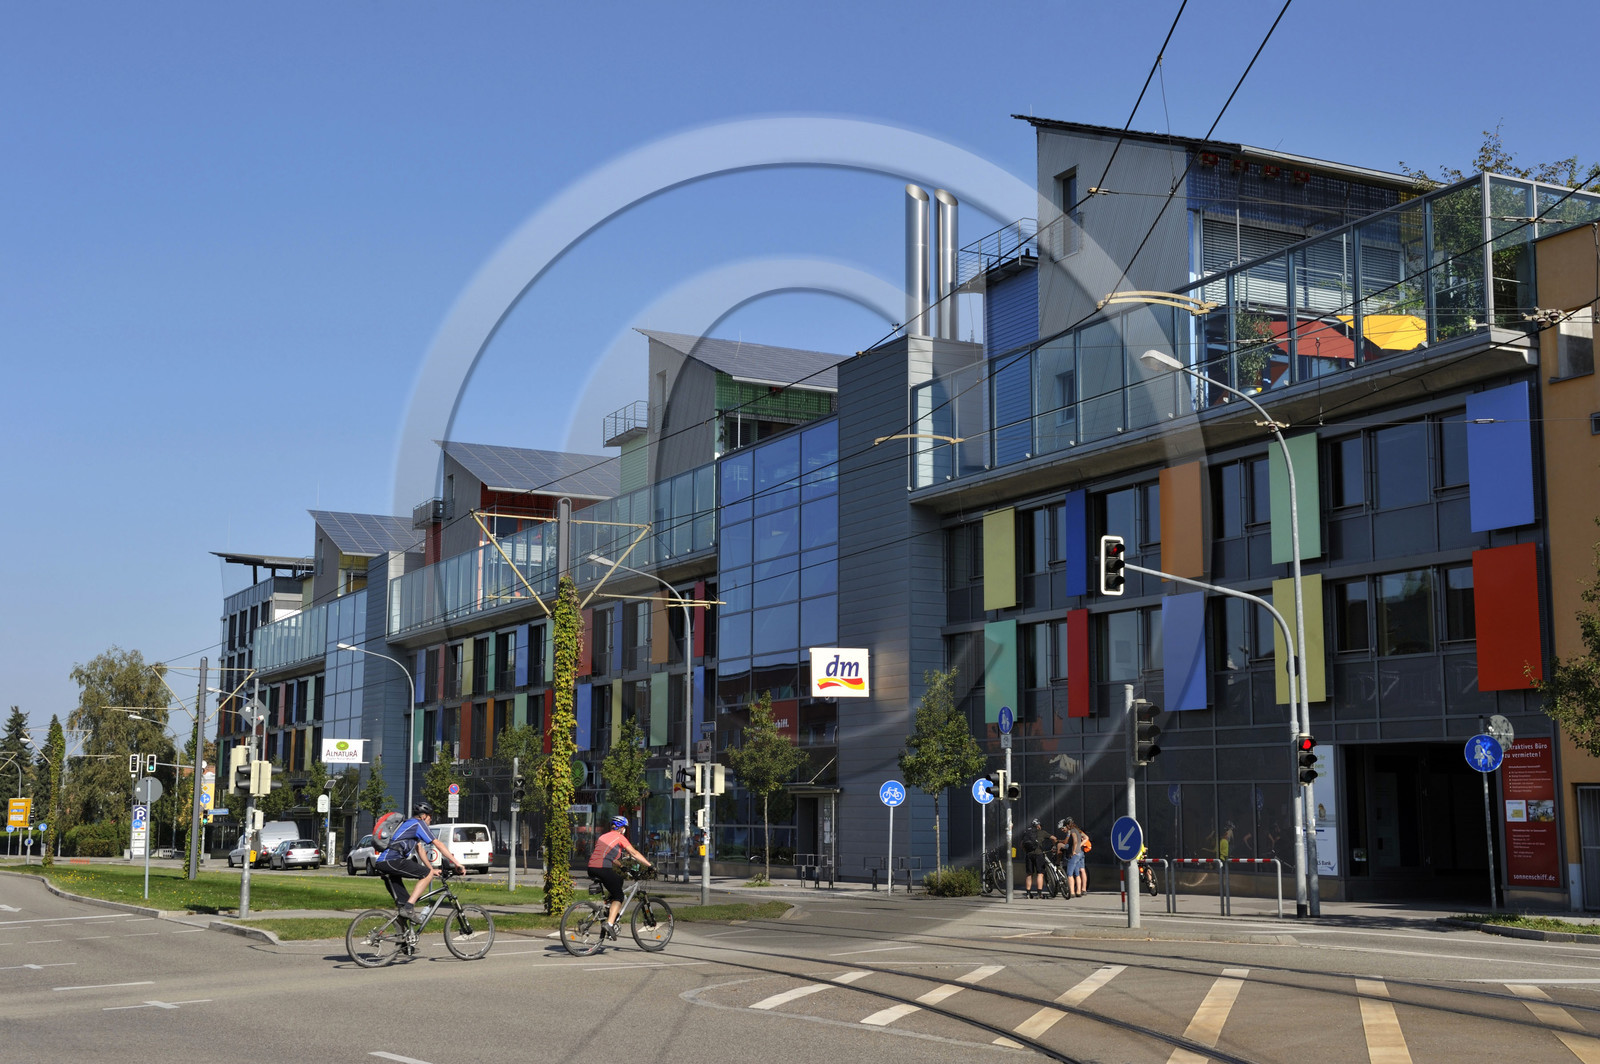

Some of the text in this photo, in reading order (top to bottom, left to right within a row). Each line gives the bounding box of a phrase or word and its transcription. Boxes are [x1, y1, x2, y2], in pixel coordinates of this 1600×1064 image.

[826, 655, 859, 677] dm
[326, 749, 358, 757] ALNATURA
[1513, 873, 1556, 881] sonnenschiff.de
